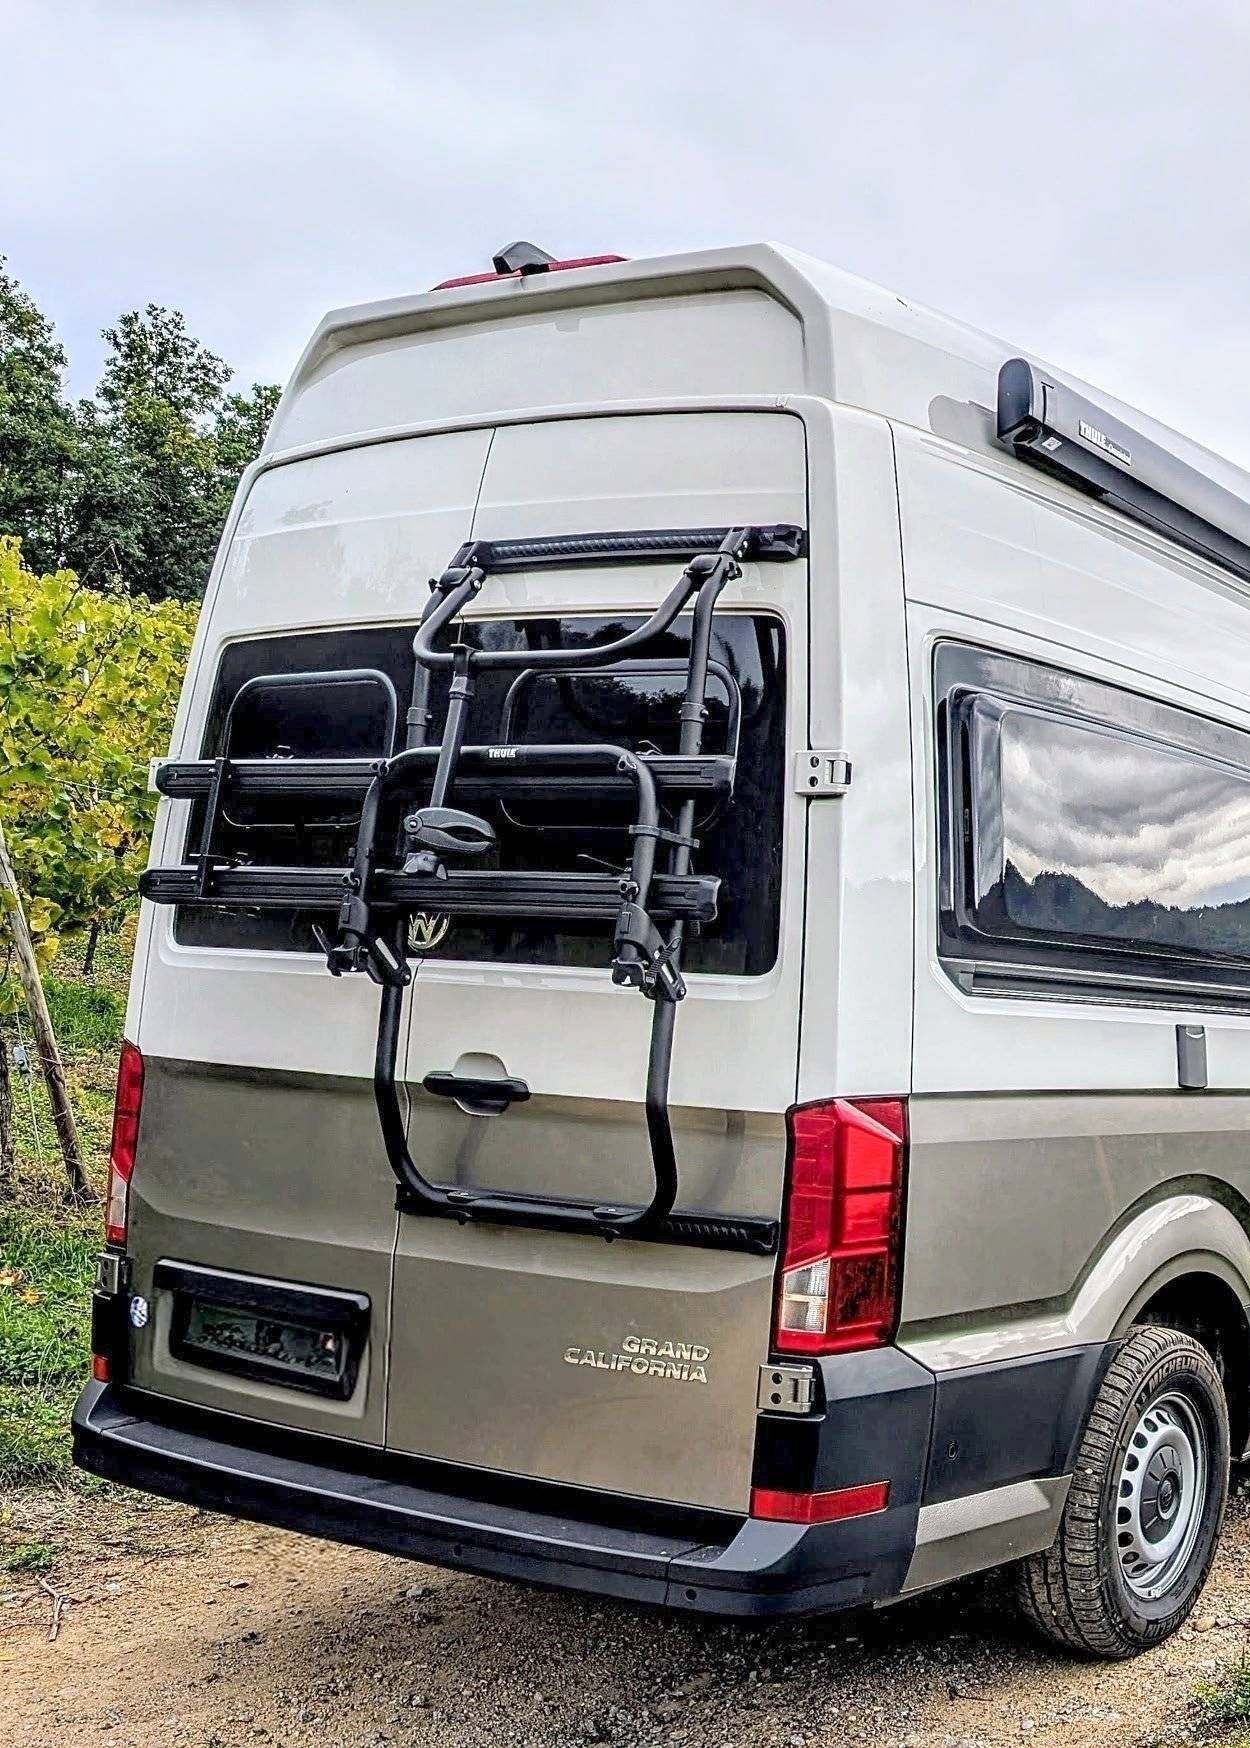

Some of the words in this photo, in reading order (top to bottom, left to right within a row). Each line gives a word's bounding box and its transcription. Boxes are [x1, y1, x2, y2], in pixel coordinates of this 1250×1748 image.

[1079, 420, 1107, 445] THULE
[489, 748, 517, 758] THULE
[622, 1335, 710, 1362] GRAND
[563, 1347, 708, 1384] CALIFORNIA
[1148, 1356, 1201, 1394] MICHELIN
